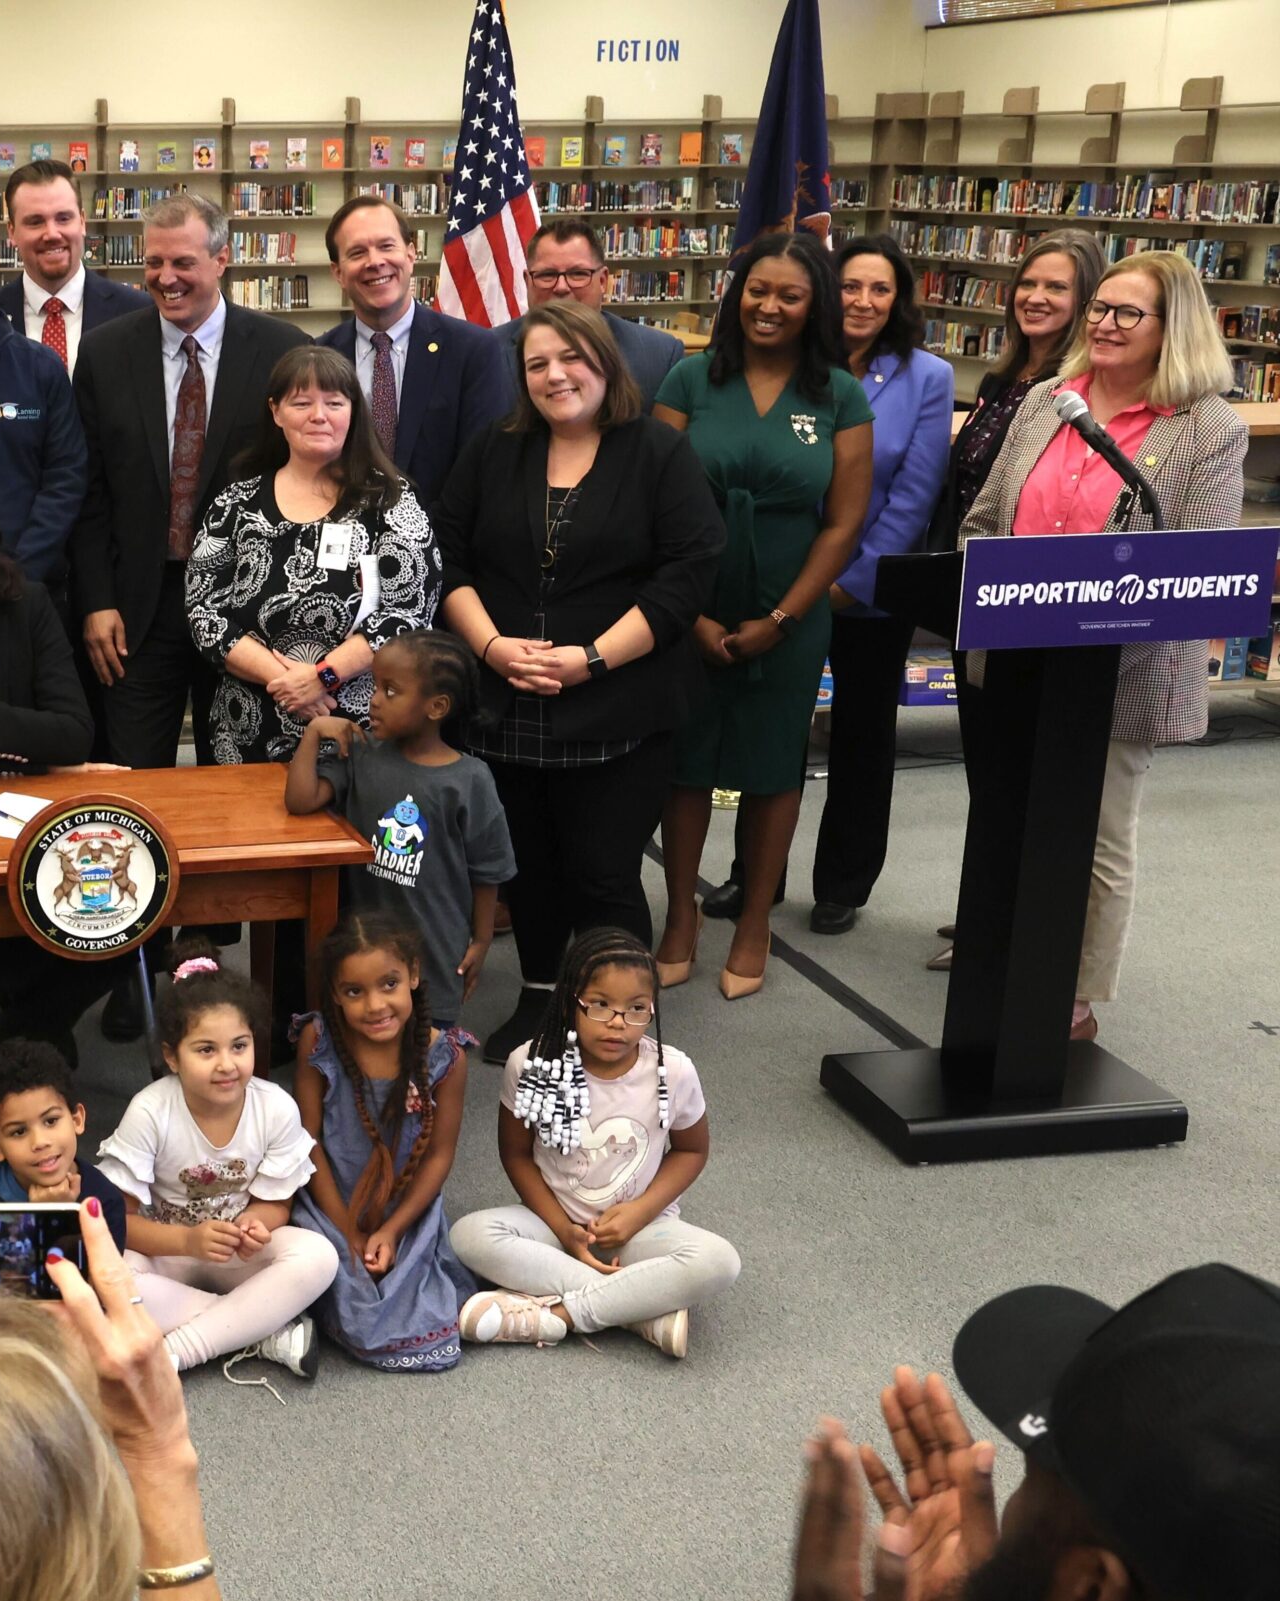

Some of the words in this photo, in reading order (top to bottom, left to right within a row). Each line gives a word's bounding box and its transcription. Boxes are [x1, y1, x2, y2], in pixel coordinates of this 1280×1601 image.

[597, 39, 679, 62] FICTION
[976, 579, 1113, 607] SUPPORTING
[1145, 574, 1259, 601] STUDENTS
[38, 818, 75, 851] STATE
[74, 812, 92, 826] OF
[94, 811, 154, 844] MICHIGAN
[366, 863, 417, 888] INTERNATIONAL
[65, 932, 129, 950] GOVERNOR
